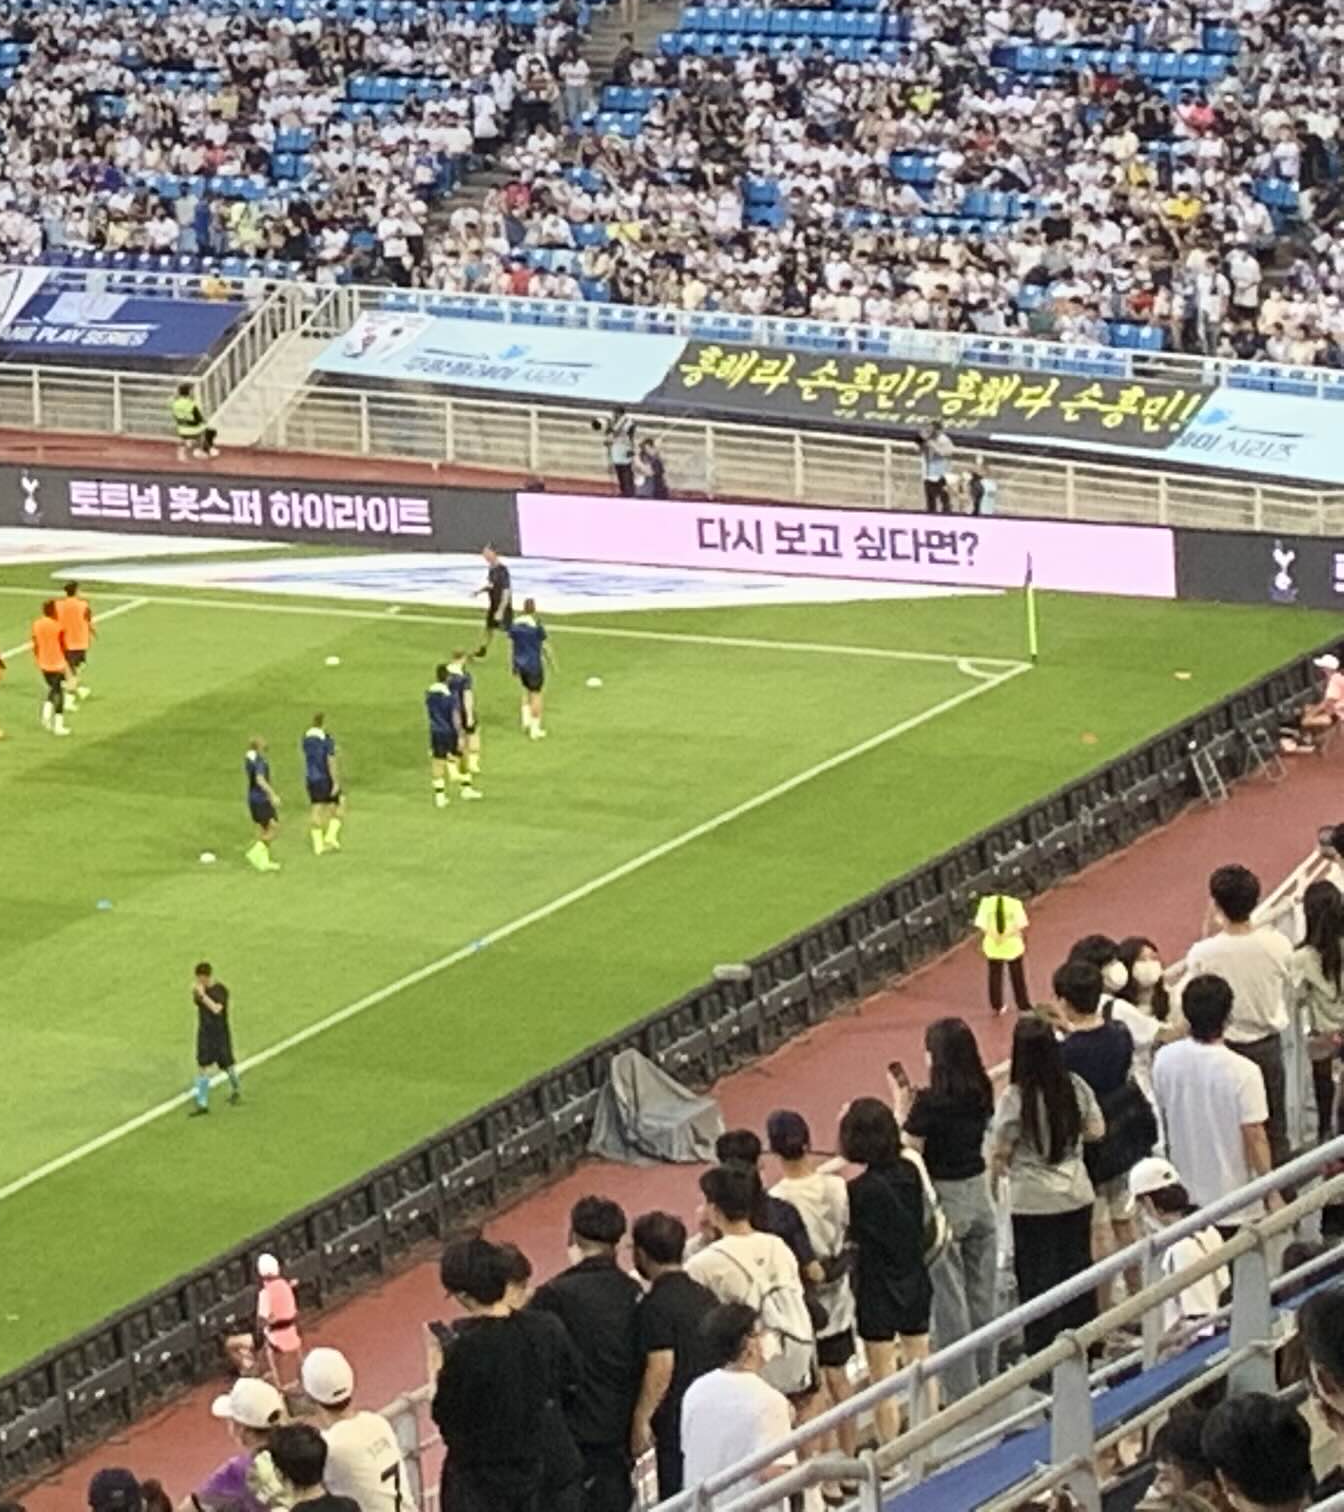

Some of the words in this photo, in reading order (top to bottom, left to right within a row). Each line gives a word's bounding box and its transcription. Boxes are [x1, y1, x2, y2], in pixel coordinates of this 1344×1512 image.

[37, 326, 84, 344] PLAY
[79, 329, 150, 347] SERIES
[797, 359, 940, 409] 손흥민?
[68, 478, 161, 522] 토트넘
[270, 489, 433, 537] 하이라이트
[697, 516, 764, 555] 다시
[775, 521, 843, 559] 보고
[853, 524, 980, 567] 싶다면?
